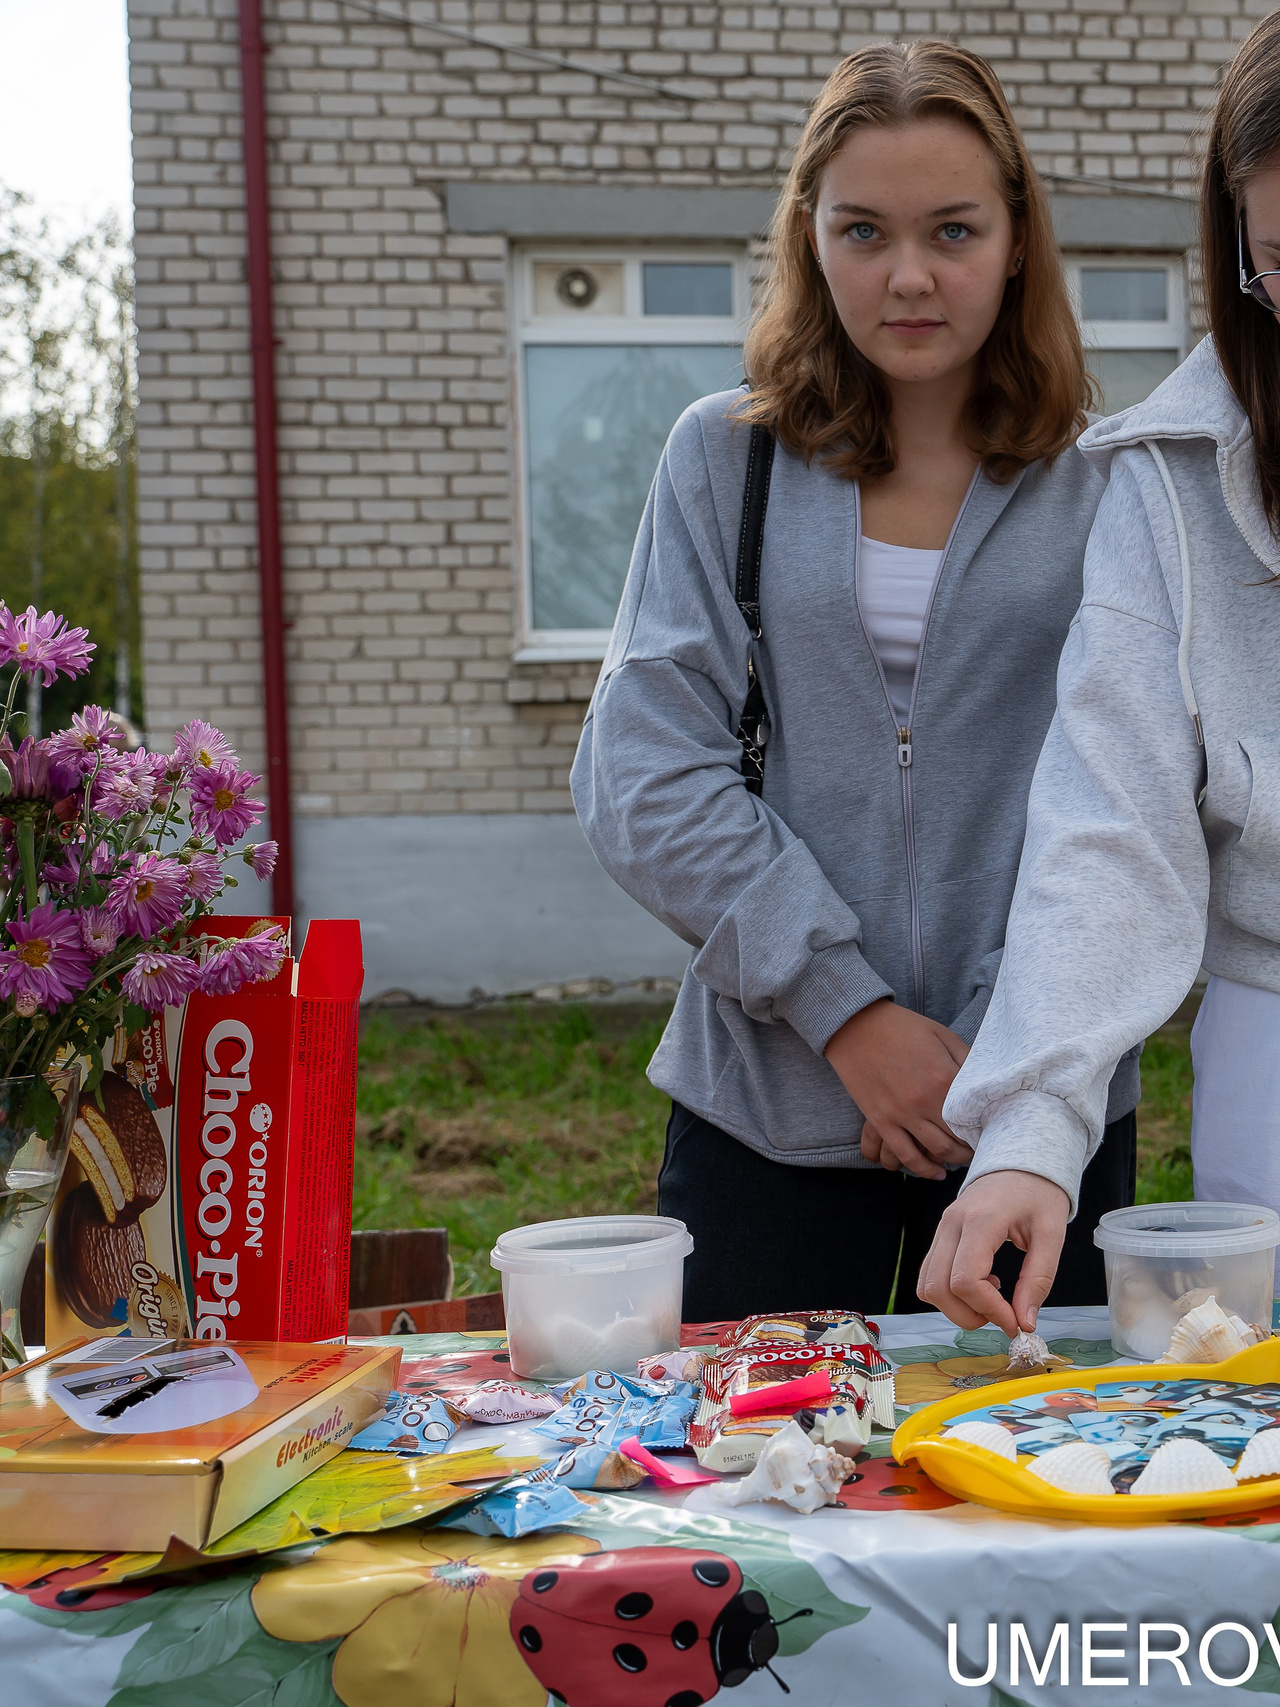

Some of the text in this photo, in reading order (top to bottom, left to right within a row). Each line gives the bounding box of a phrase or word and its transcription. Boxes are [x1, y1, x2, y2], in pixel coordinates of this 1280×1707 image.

[300, 1001, 308, 1025] МАССА
[155, 1030, 164, 1063] ORION
[244, 1140, 268, 1249] ORION
[286, 1259, 294, 1284] МАССА
[284, 1285, 293, 1306] НЕТТО
[276, 1405, 344, 1468] Electronic
[302, 1422, 353, 1463] Kitchen scale
